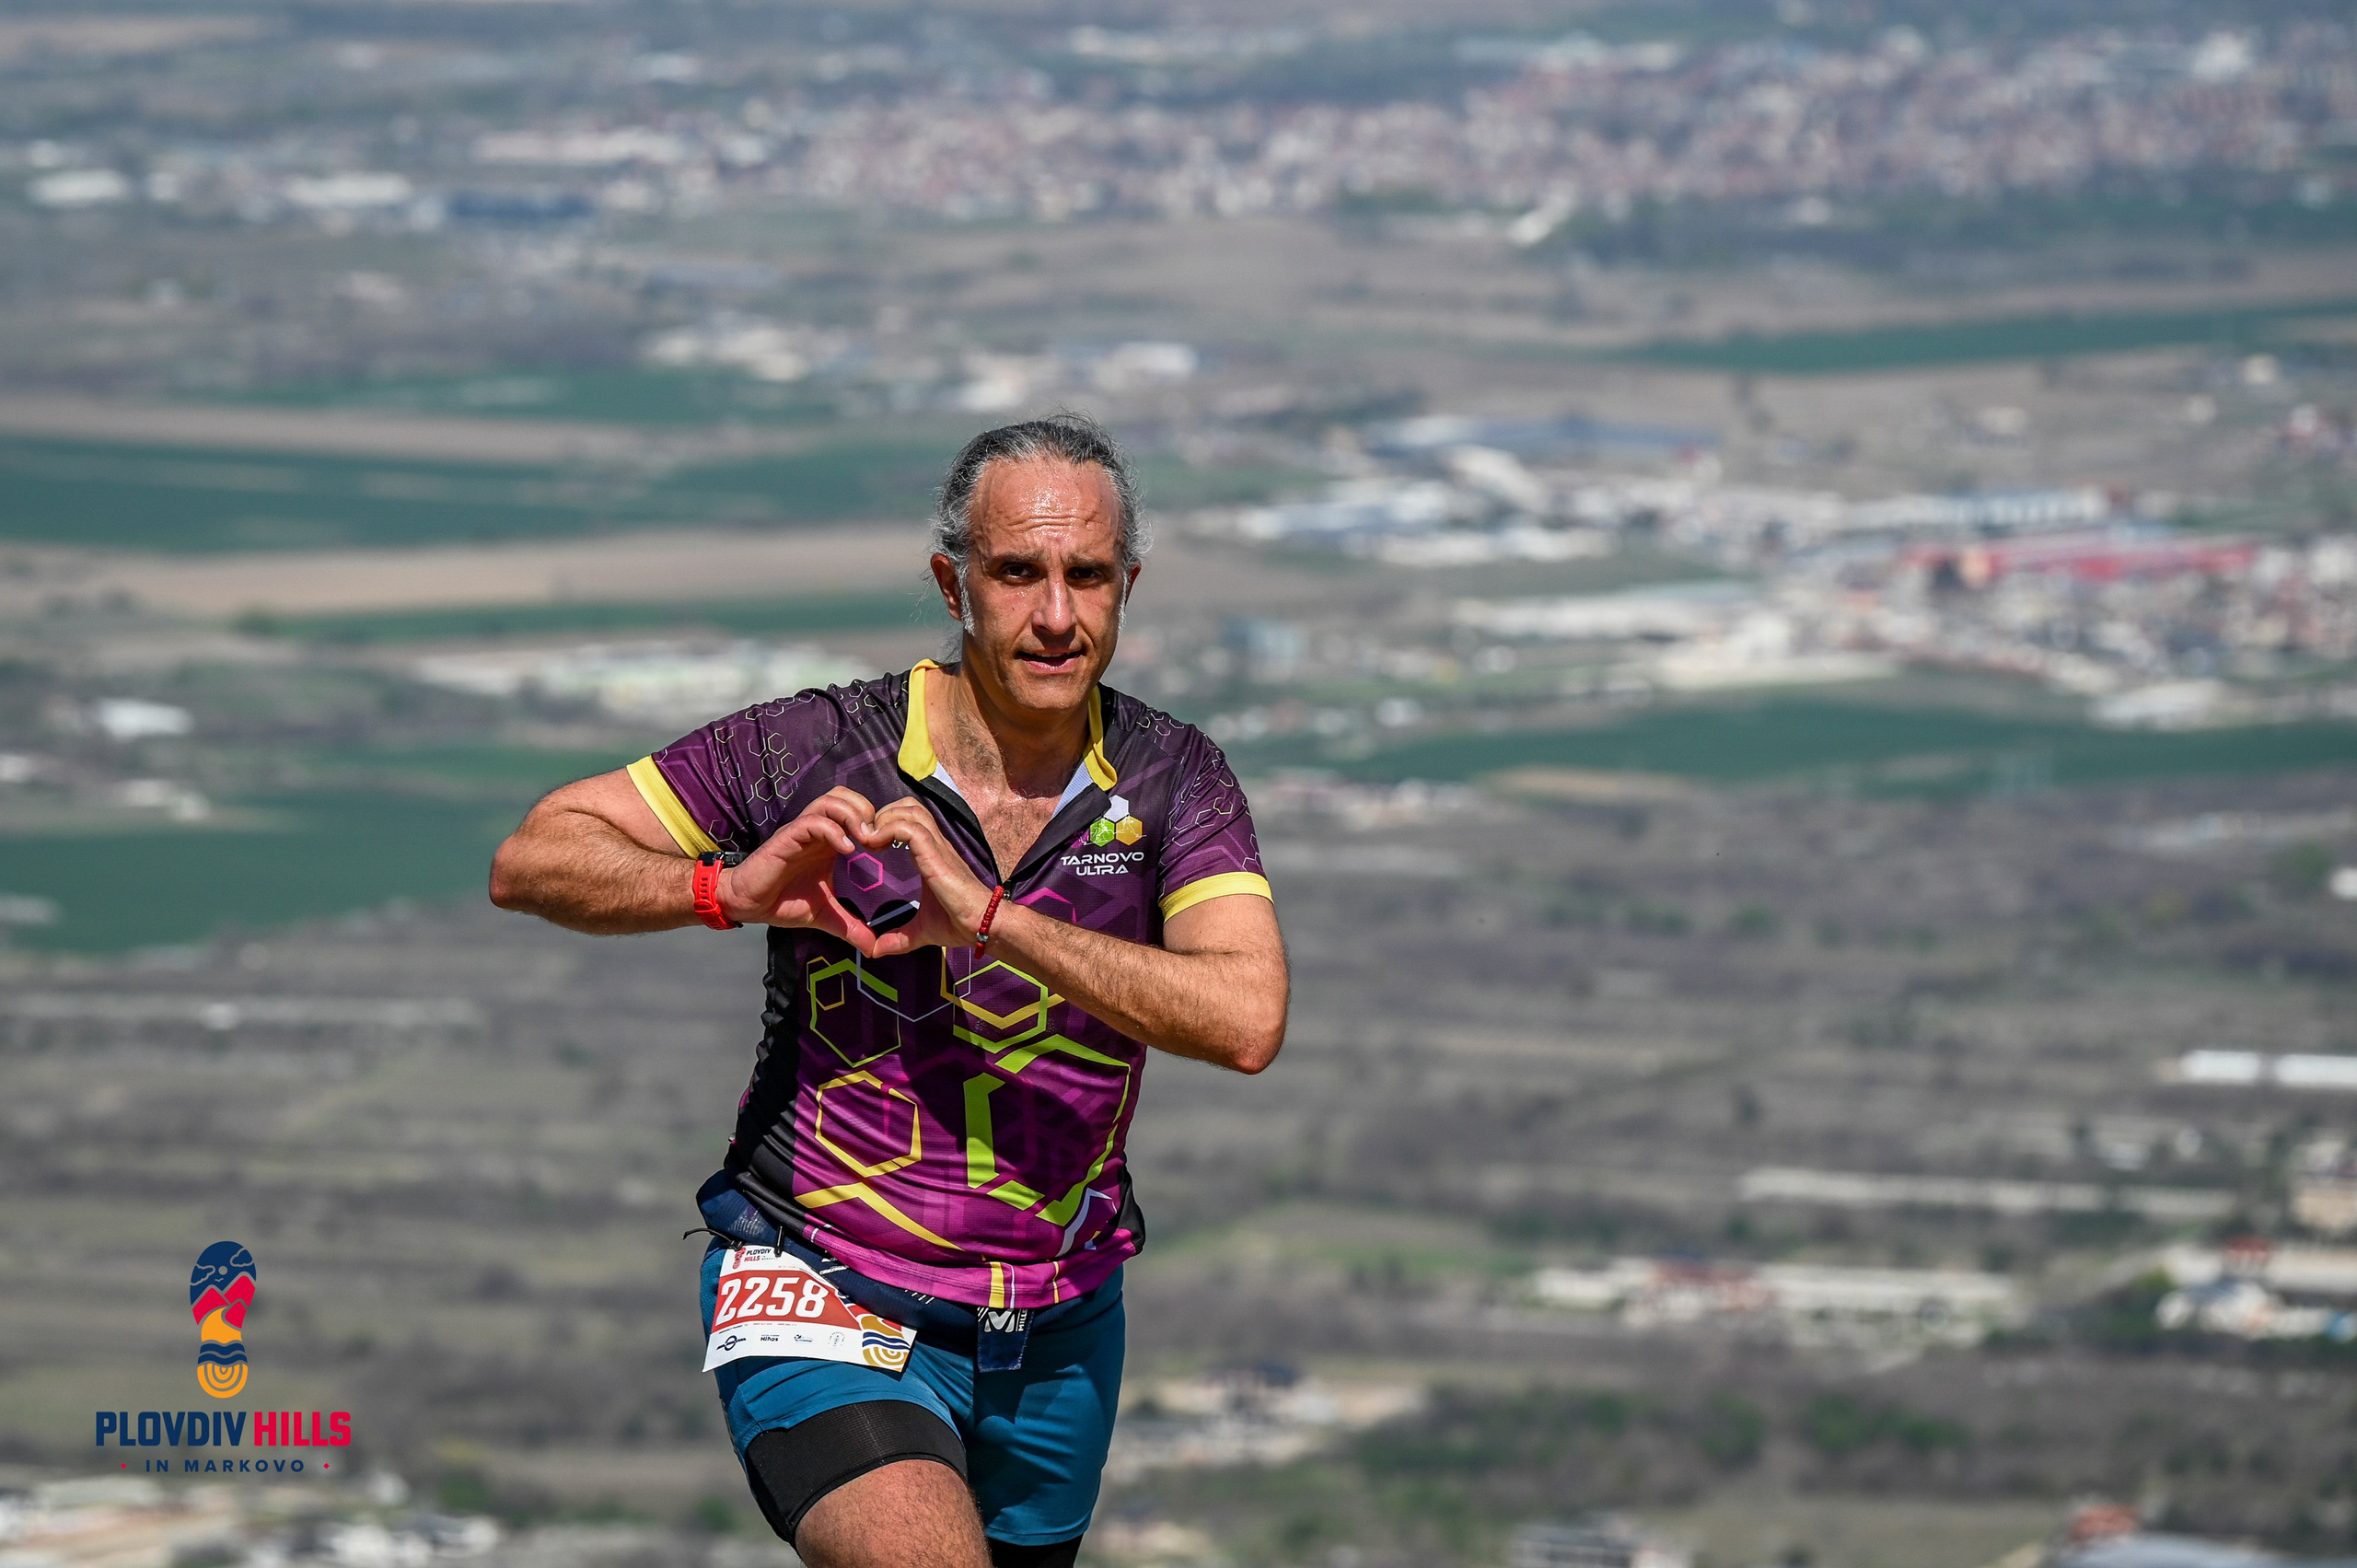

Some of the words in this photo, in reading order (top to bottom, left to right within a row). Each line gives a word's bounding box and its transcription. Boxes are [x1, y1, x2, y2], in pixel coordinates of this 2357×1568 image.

[1060, 852, 1144, 866] TARNOVO
[1075, 864, 1129, 877] ULTRA
[714, 1276, 829, 1327] 2258
